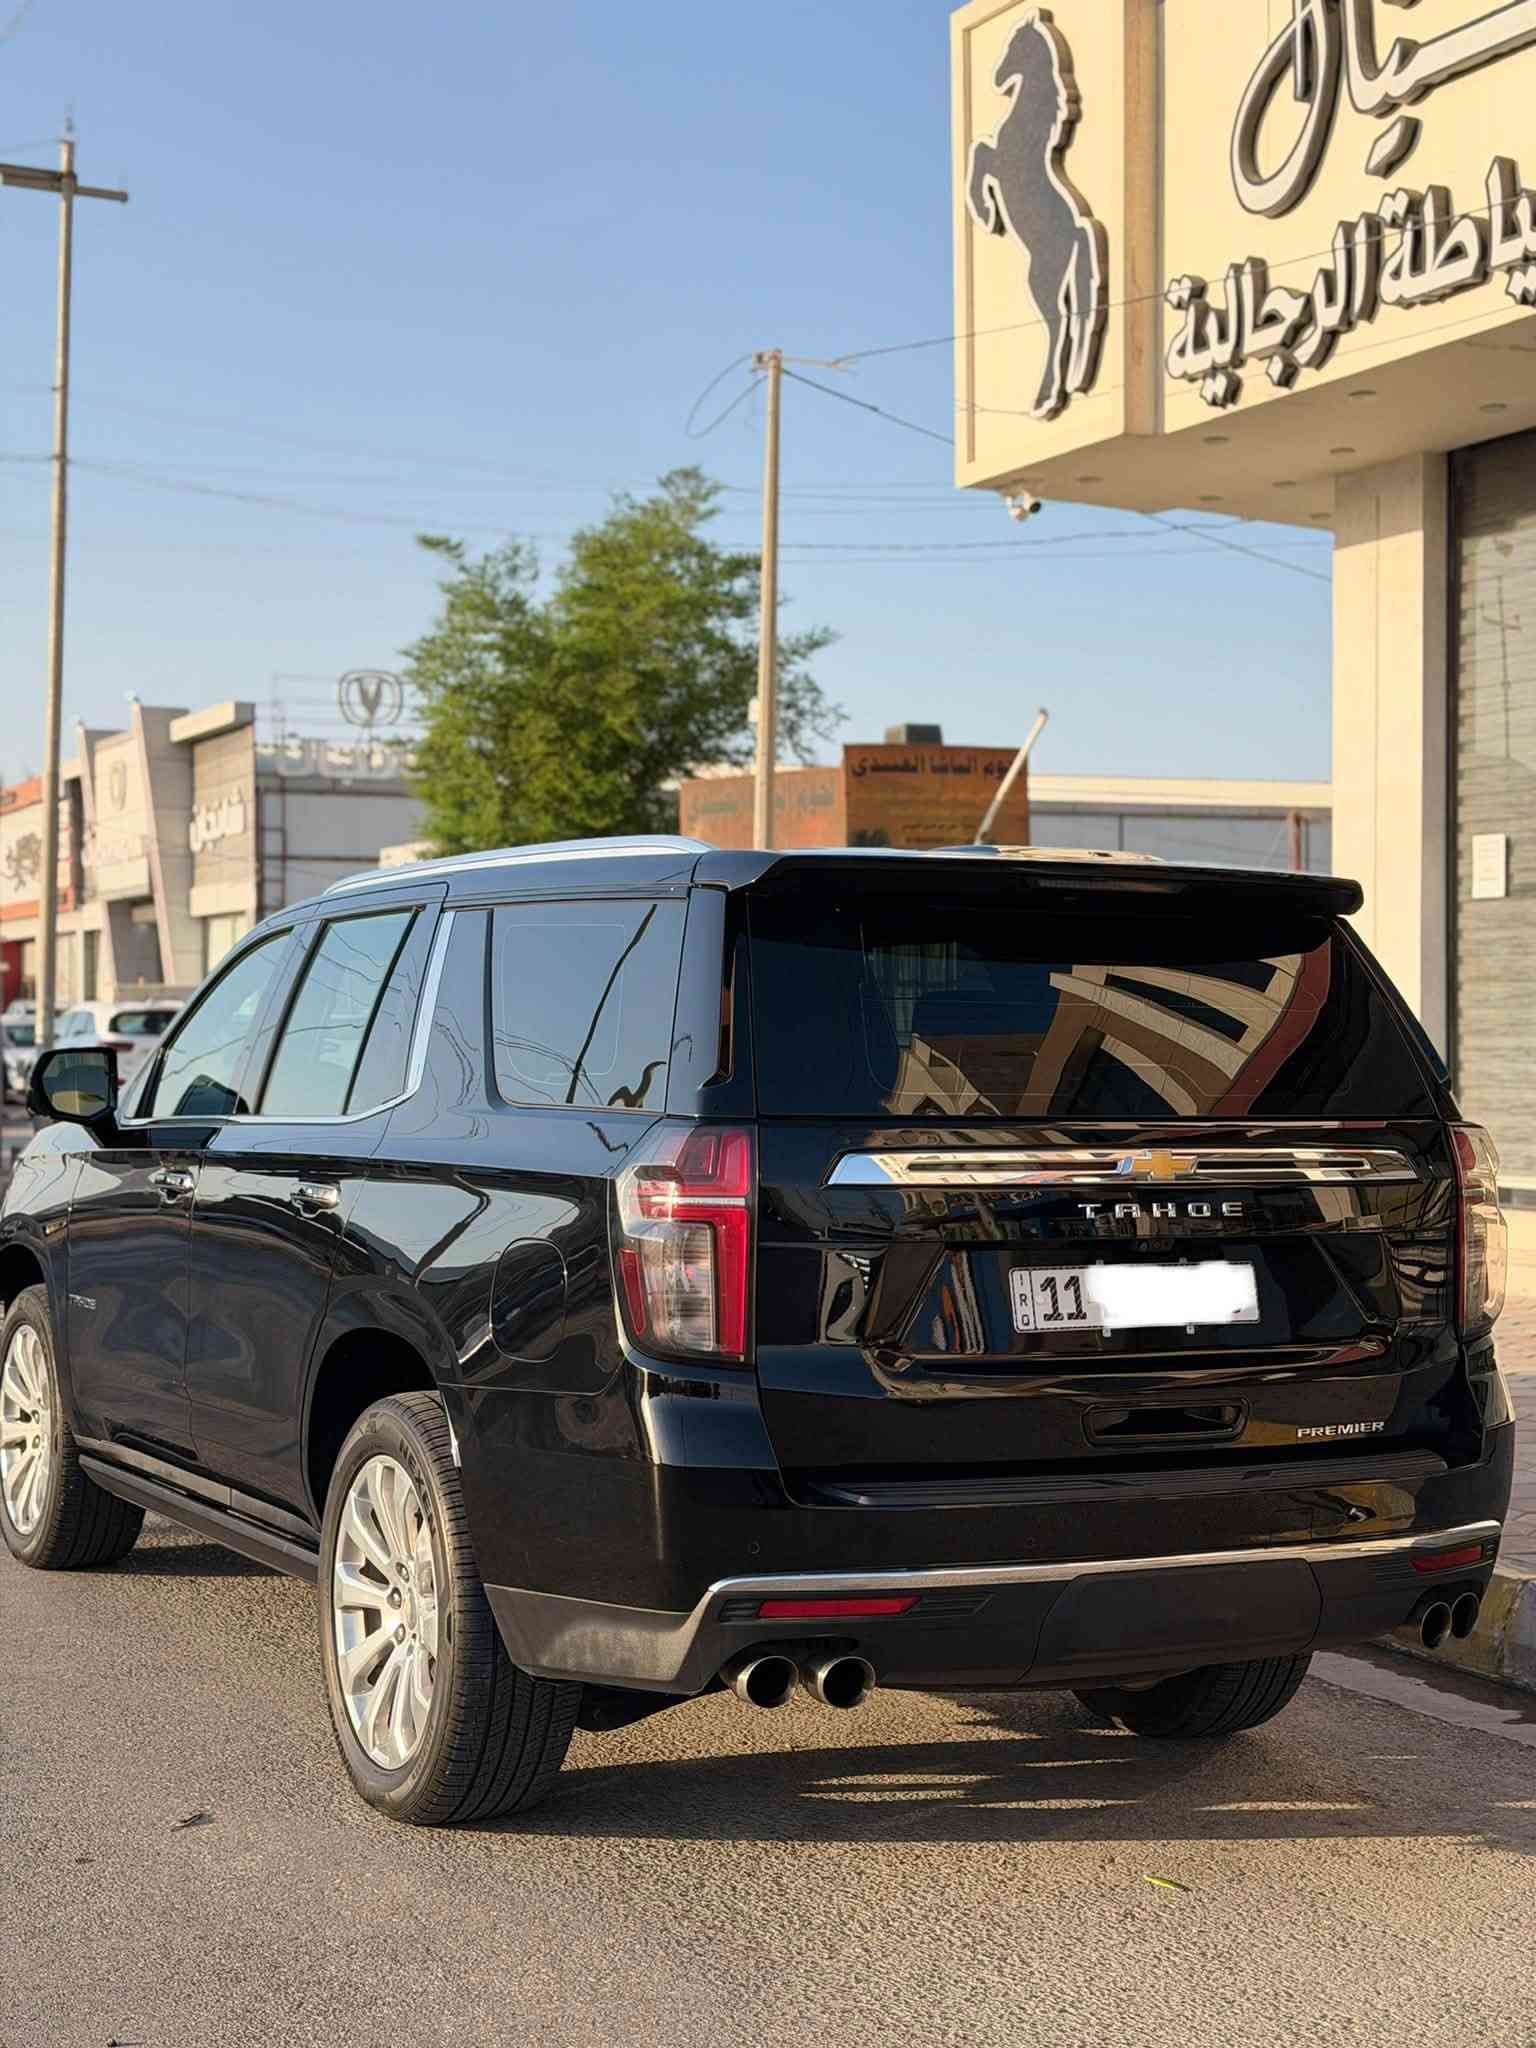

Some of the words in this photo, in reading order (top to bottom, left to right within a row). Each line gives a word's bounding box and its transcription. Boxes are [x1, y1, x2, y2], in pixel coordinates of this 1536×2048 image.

[1165, 212, 1379, 407] الرجالية
[1078, 1201, 1243, 1218] TAHOE
[1039, 1275, 1088, 1321] 11
[1297, 1421, 1385, 1438] PREMIER
